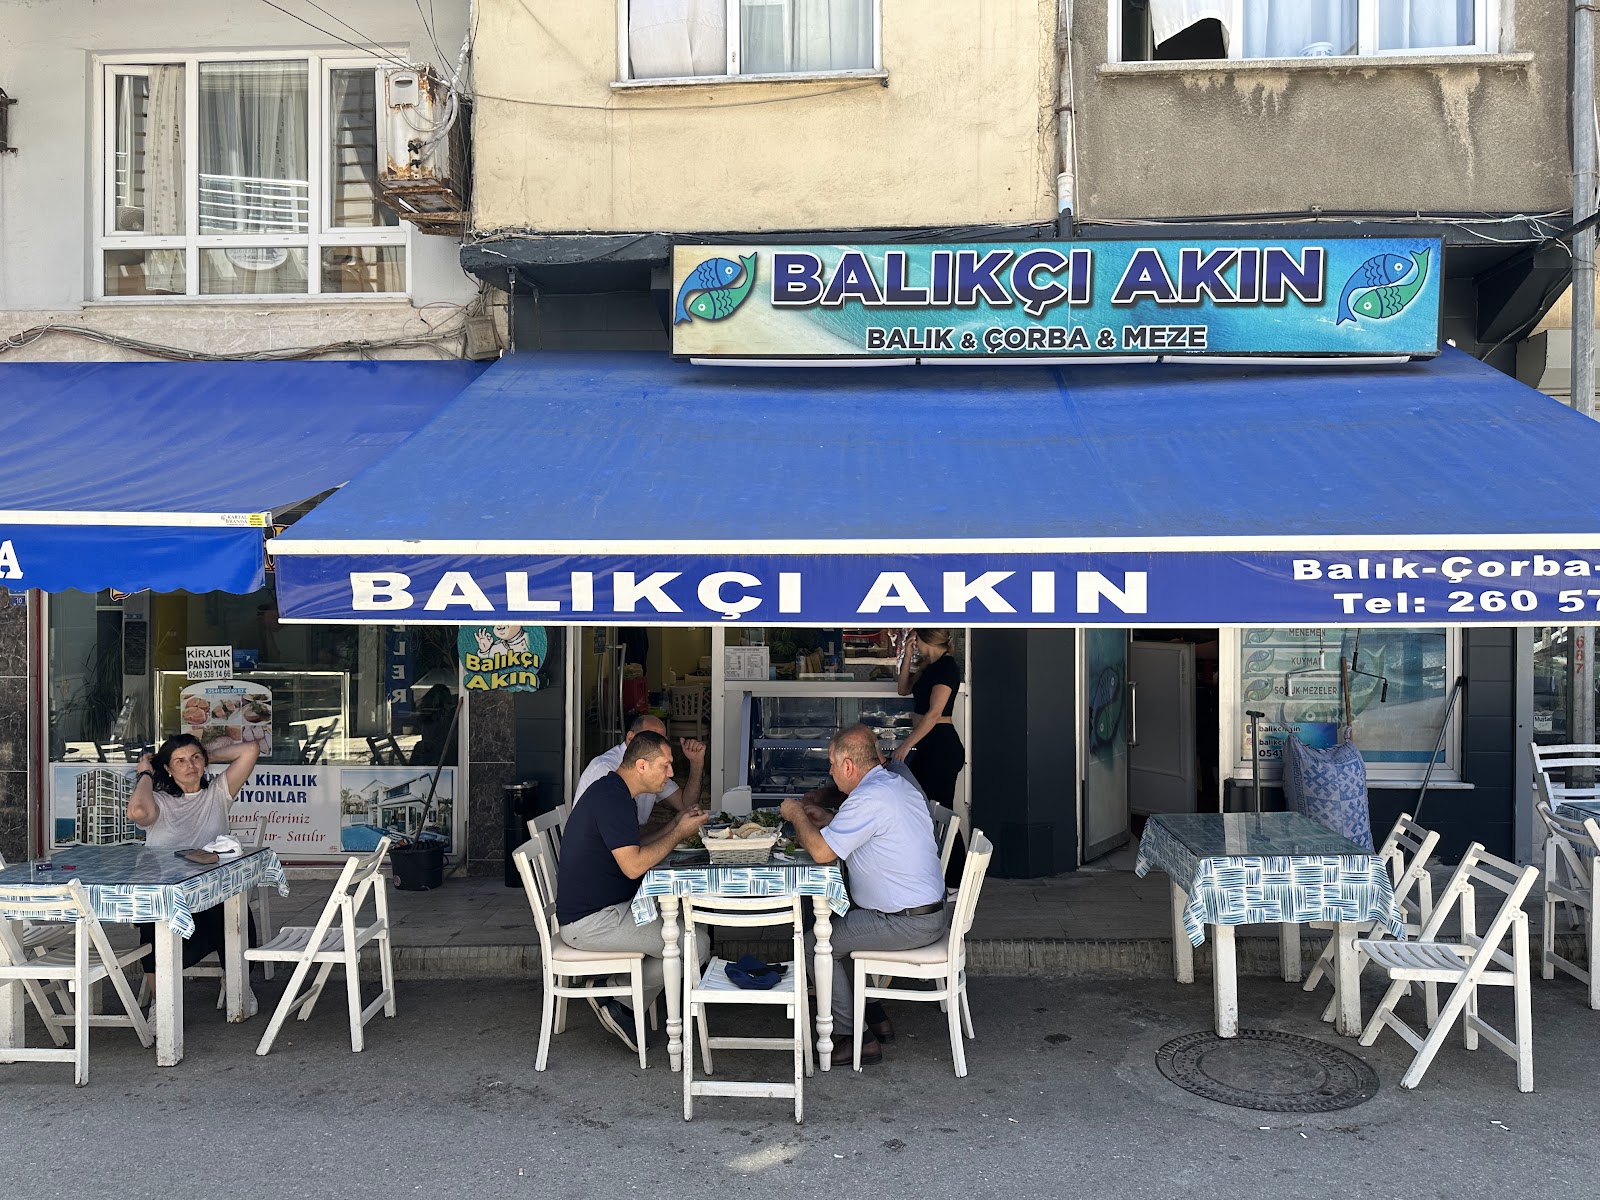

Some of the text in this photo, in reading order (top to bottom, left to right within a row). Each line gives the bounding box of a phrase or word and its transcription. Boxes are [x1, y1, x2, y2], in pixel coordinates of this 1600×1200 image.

[771, 247, 1324, 316] BALIKÇI AKIN
[866, 325, 1207, 353] BALIK & ÇORBA & MEZE
[349, 571, 1148, 620] BALIKÇI AKIN
[1333, 592, 1426, 613] Tel:
[1447, 590, 1538, 612] 260
[187, 648, 231, 658] KİRALIK
[465, 649, 540, 672] Balıkçı
[188, 658, 230, 670] PANSİYON
[188, 670, 202, 678] 0549
[465, 671, 538, 691] Akın
[1303, 686, 1338, 695] MEZELER
[256, 772, 318, 787] KİRALIK
[286, 829, 326, 842] Satılır
